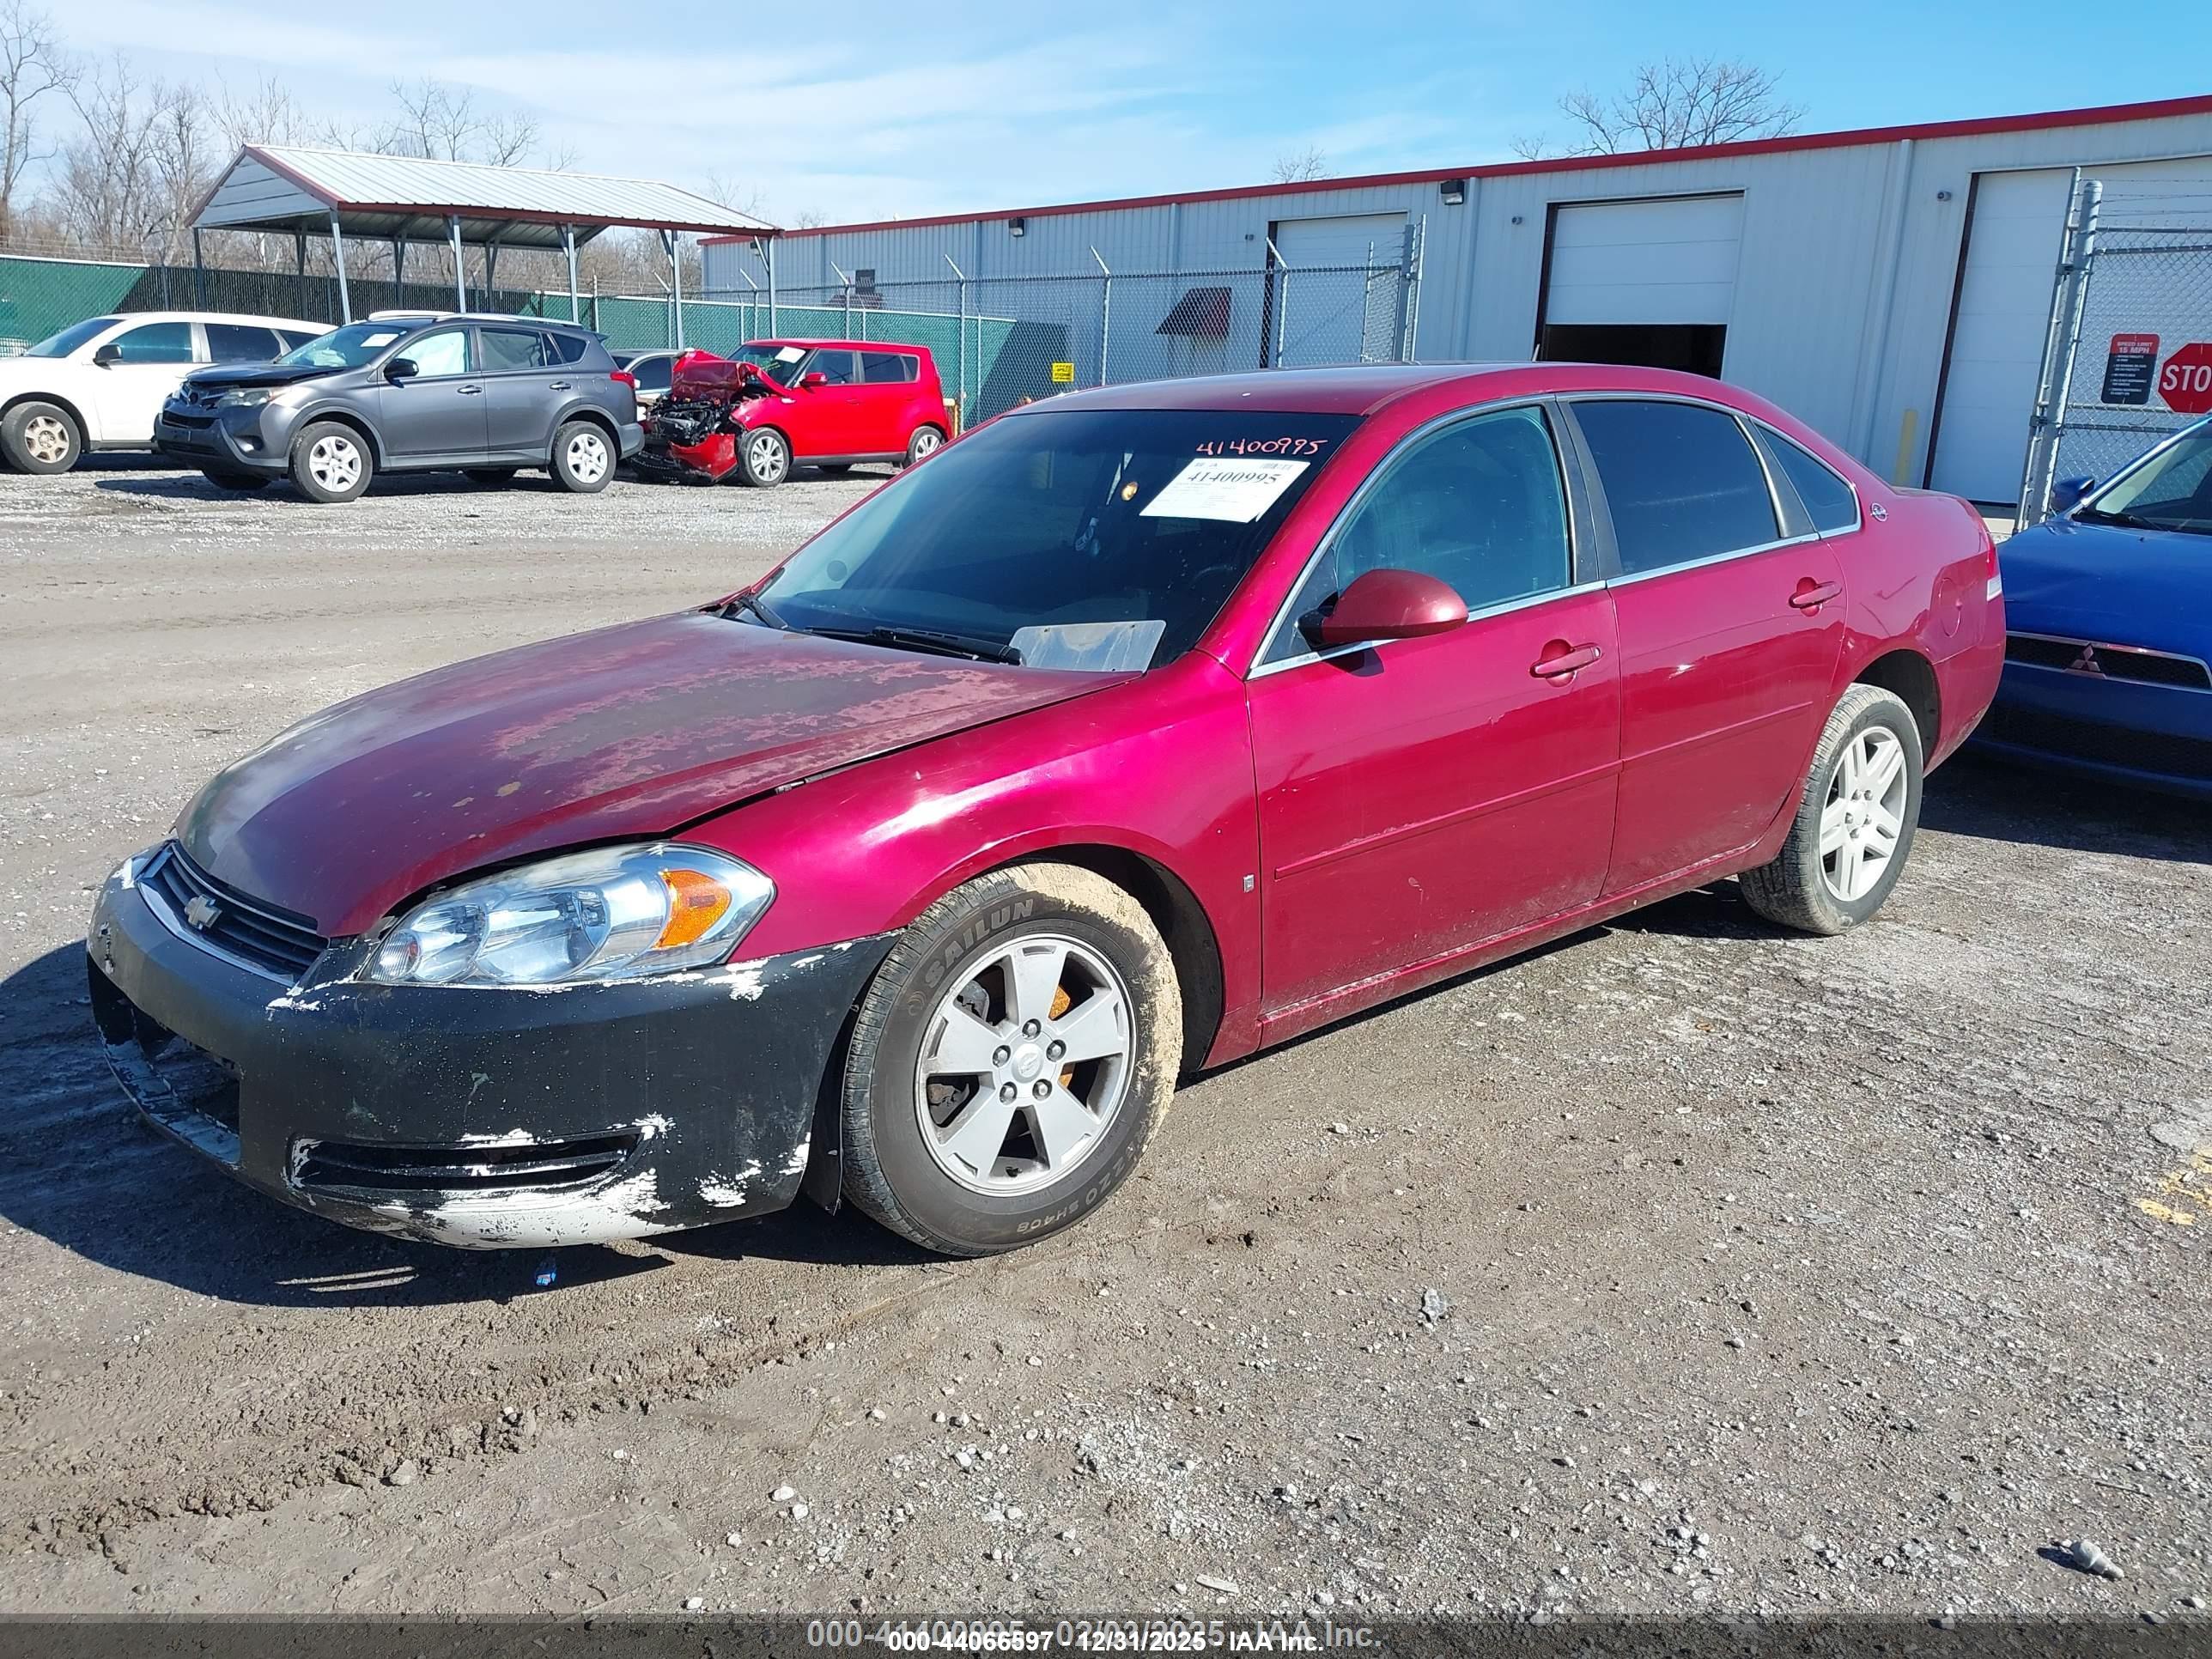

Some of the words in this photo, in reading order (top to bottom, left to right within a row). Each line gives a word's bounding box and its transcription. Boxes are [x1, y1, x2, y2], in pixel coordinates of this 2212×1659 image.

[2162, 365, 2212, 392] STO
[1195, 437, 1328, 456] 41400995
[1187, 471, 1281, 485] 41400995
[925, 898, 1034, 988] SAILUN
